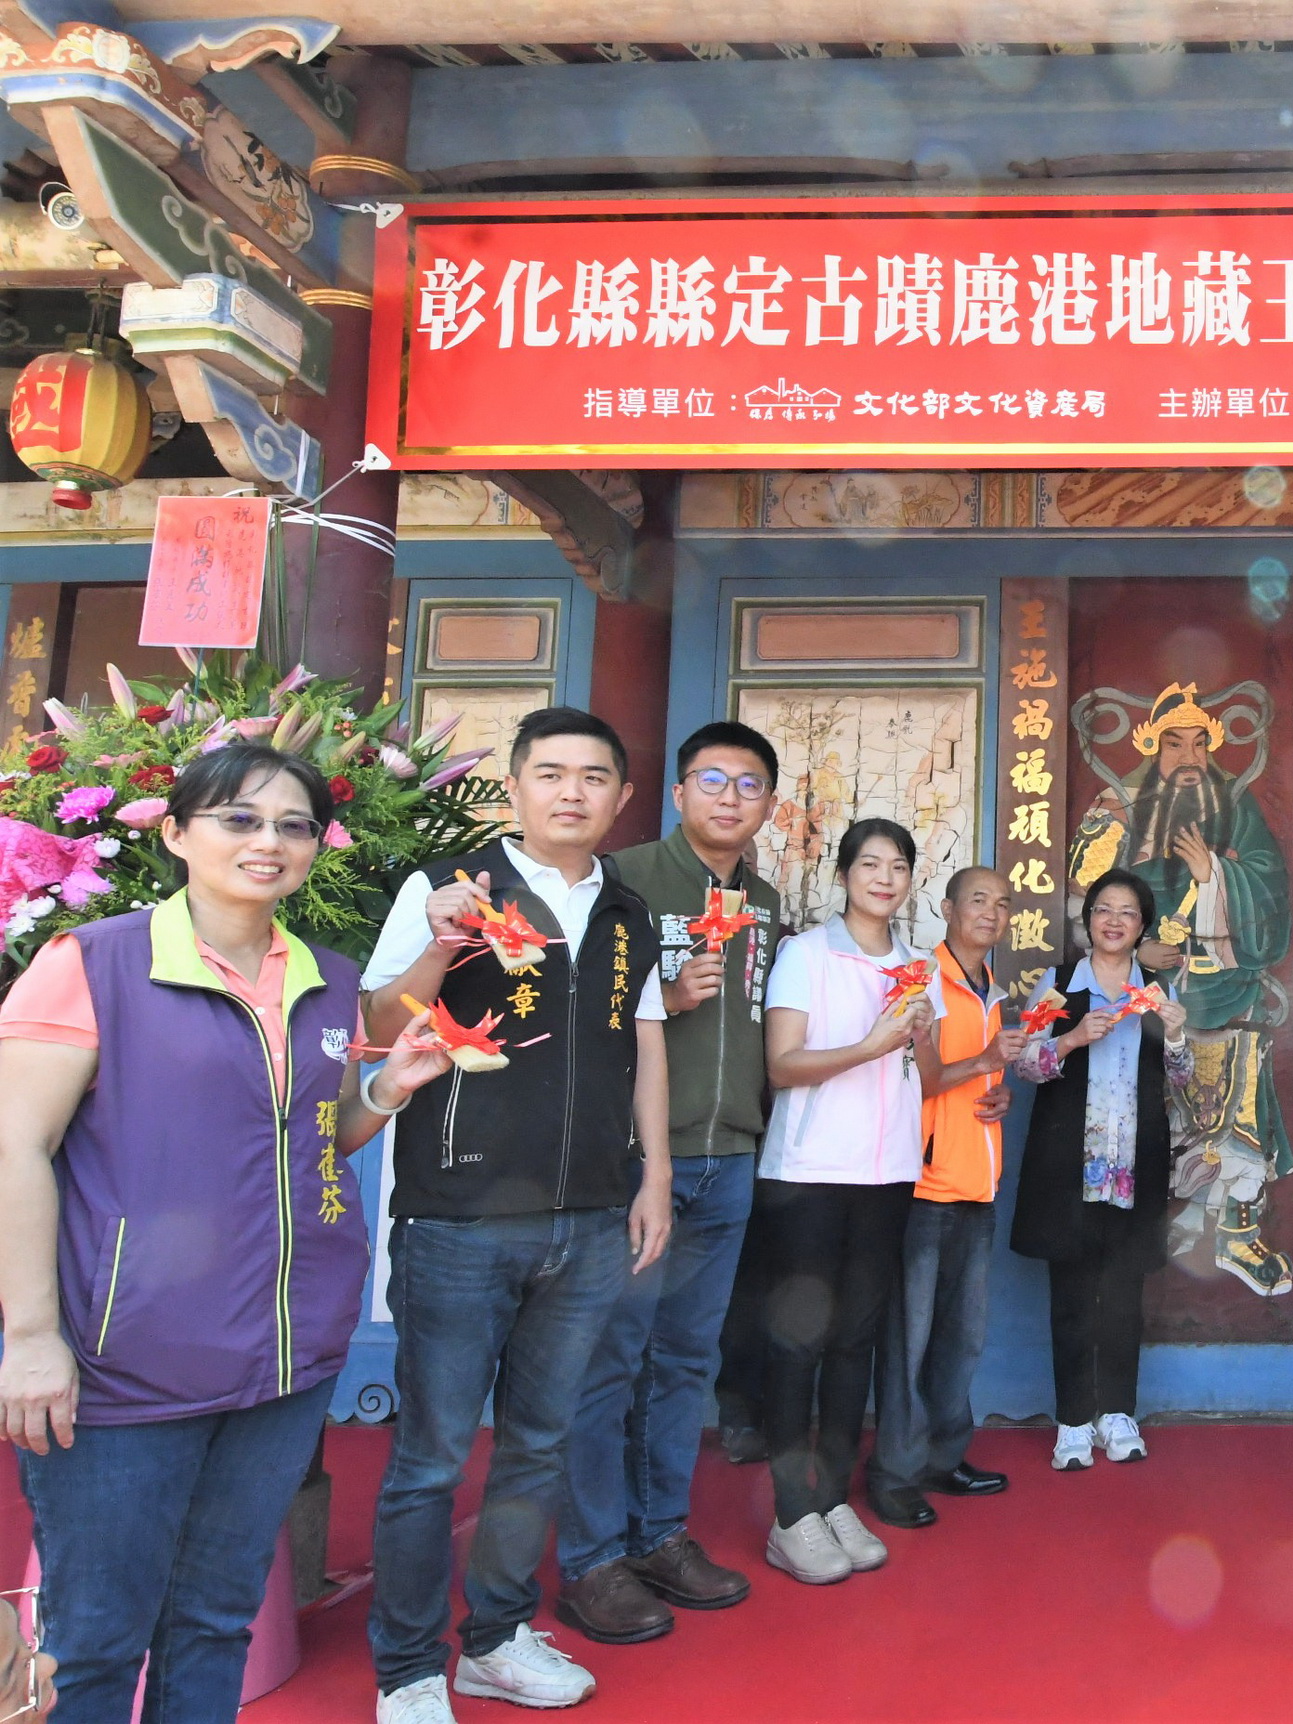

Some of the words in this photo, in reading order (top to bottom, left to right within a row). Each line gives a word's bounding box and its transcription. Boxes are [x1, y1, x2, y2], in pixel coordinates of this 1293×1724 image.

[852, 388, 1106, 420] 文化部文化資產局
[233, 506, 255, 524] 祝
[184, 515, 216, 622] 圓滿成功
[608, 922, 630, 1031] 鹿港鎮民代表
